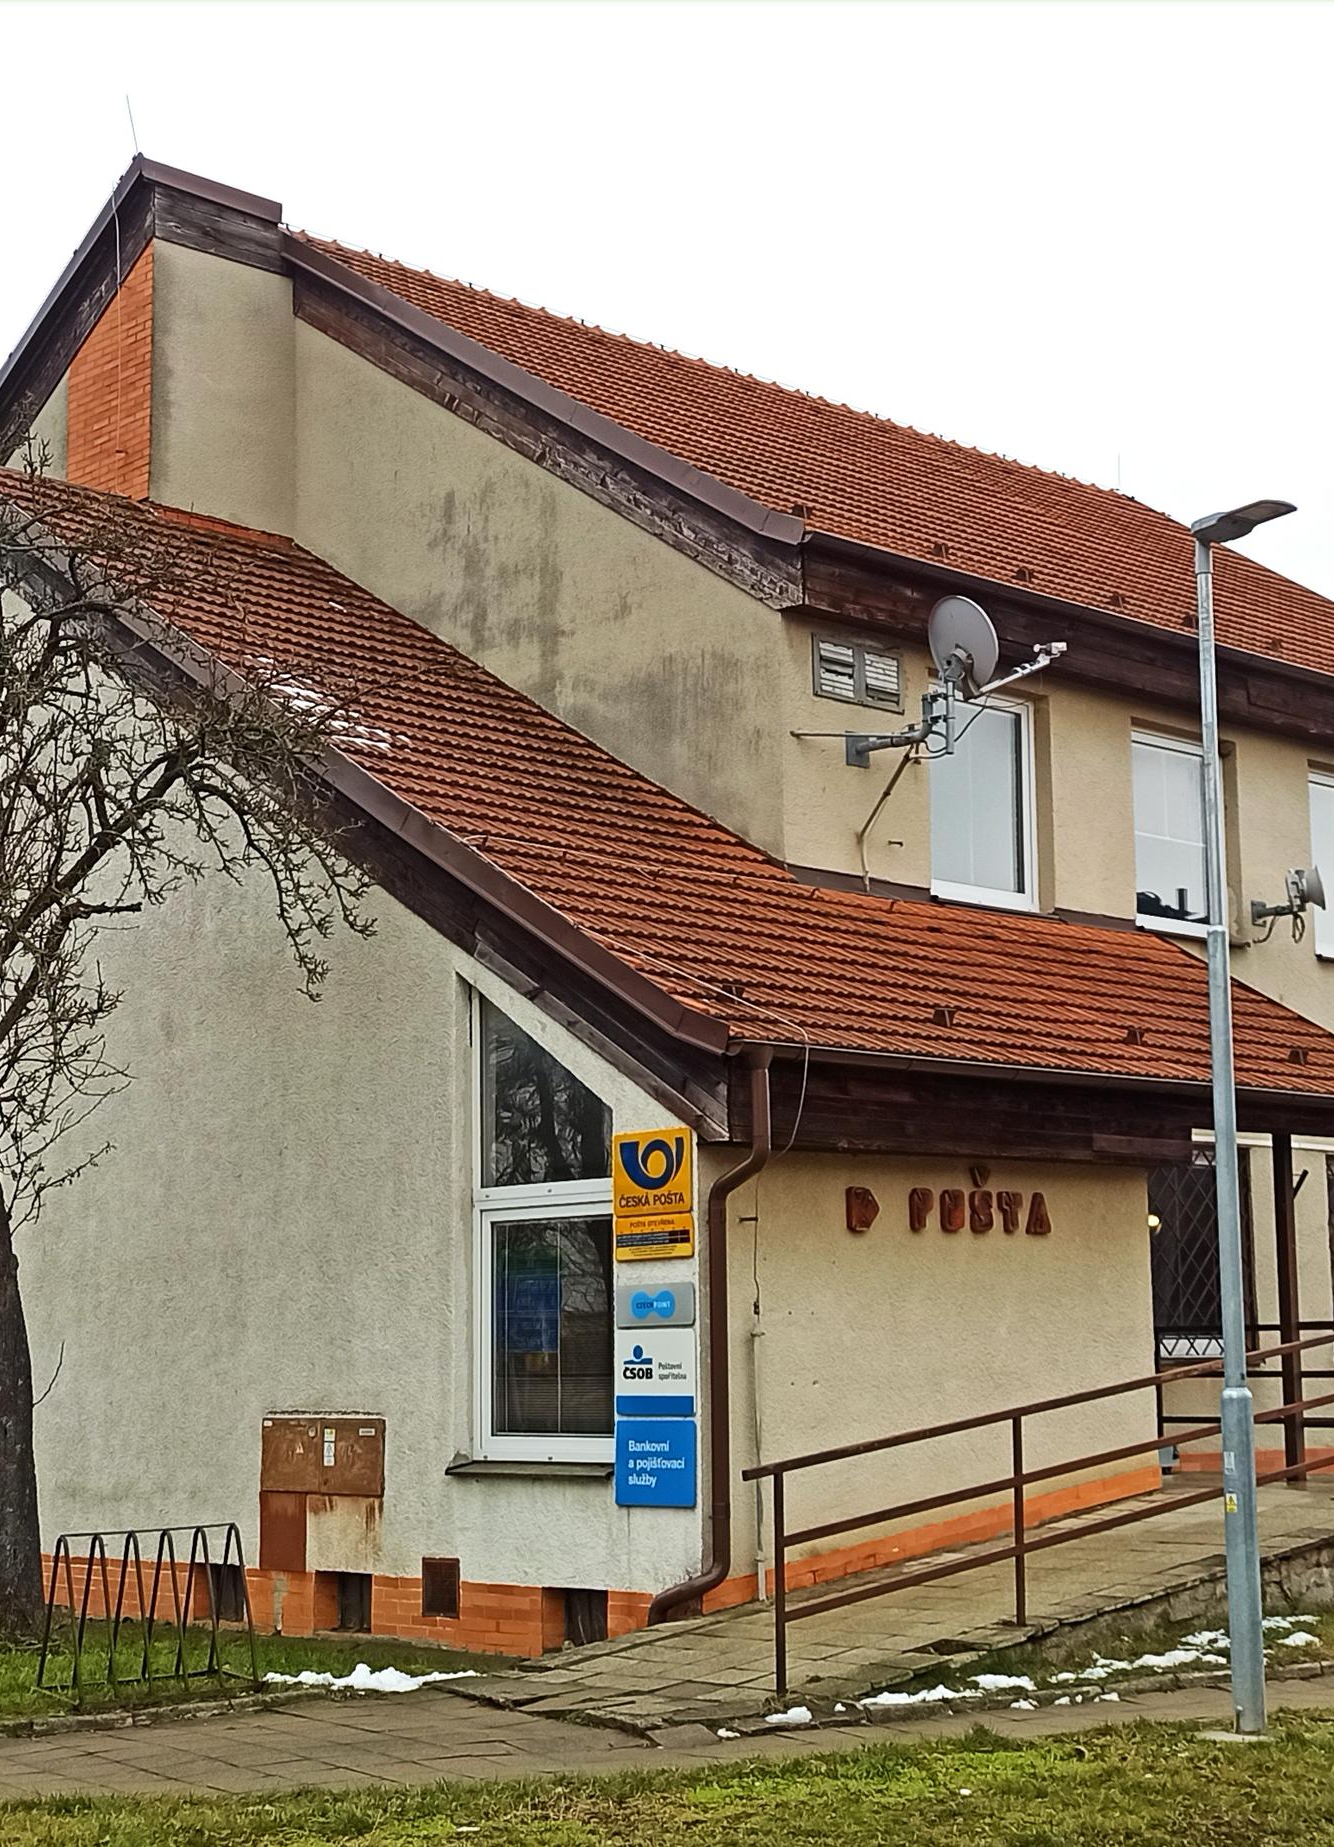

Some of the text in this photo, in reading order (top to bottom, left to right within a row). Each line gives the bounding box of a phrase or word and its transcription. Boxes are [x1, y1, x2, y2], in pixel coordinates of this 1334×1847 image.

[619, 1190, 685, 1209] ČESKÁ POŠTA
[623, 1367, 653, 1379] ČSOB
[628, 1440, 670, 1452] Bankovní
[628, 1456, 685, 1471] a pojišťovací
[628, 1474, 657, 1488] služby
